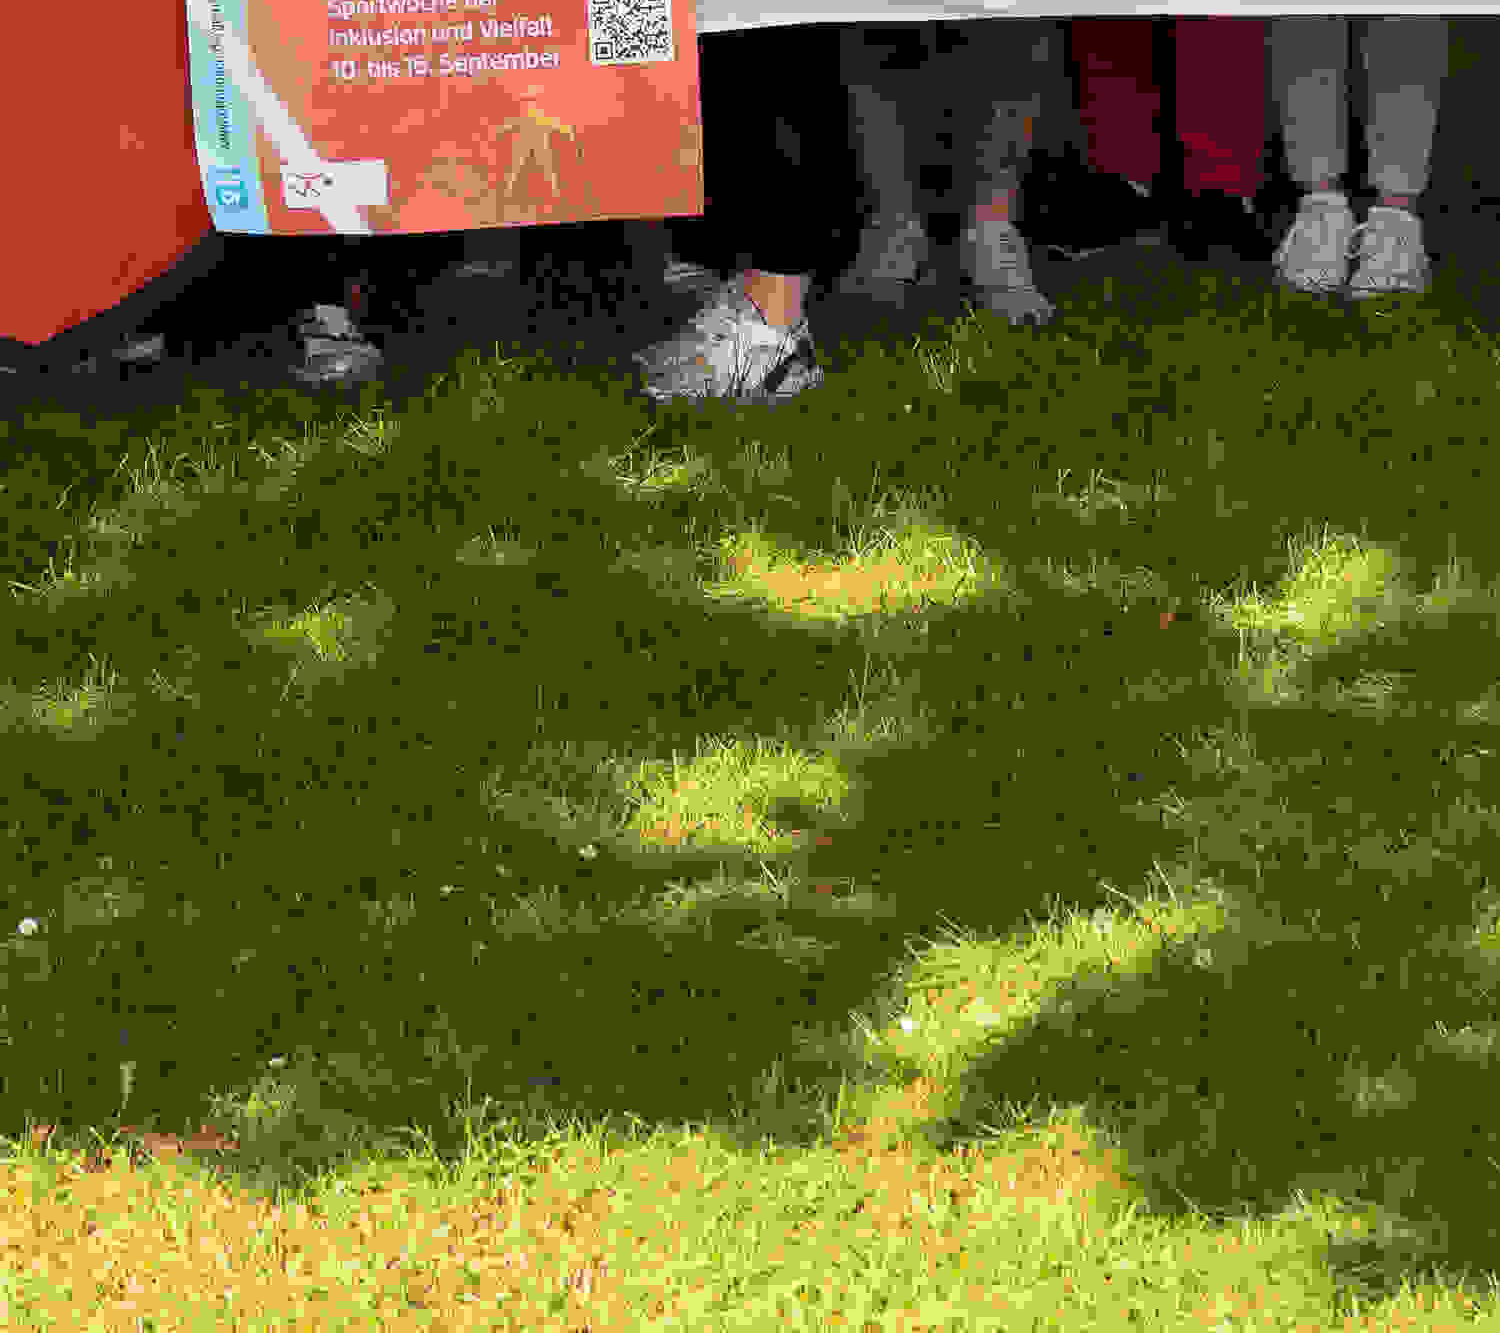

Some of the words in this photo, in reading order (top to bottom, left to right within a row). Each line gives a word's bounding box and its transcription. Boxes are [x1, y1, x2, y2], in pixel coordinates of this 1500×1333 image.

[327, 21, 424, 46] Inklusion
[431, 20, 473, 44] und
[479, 14, 553, 38] Vielfalt
[438, 47, 561, 78] September
